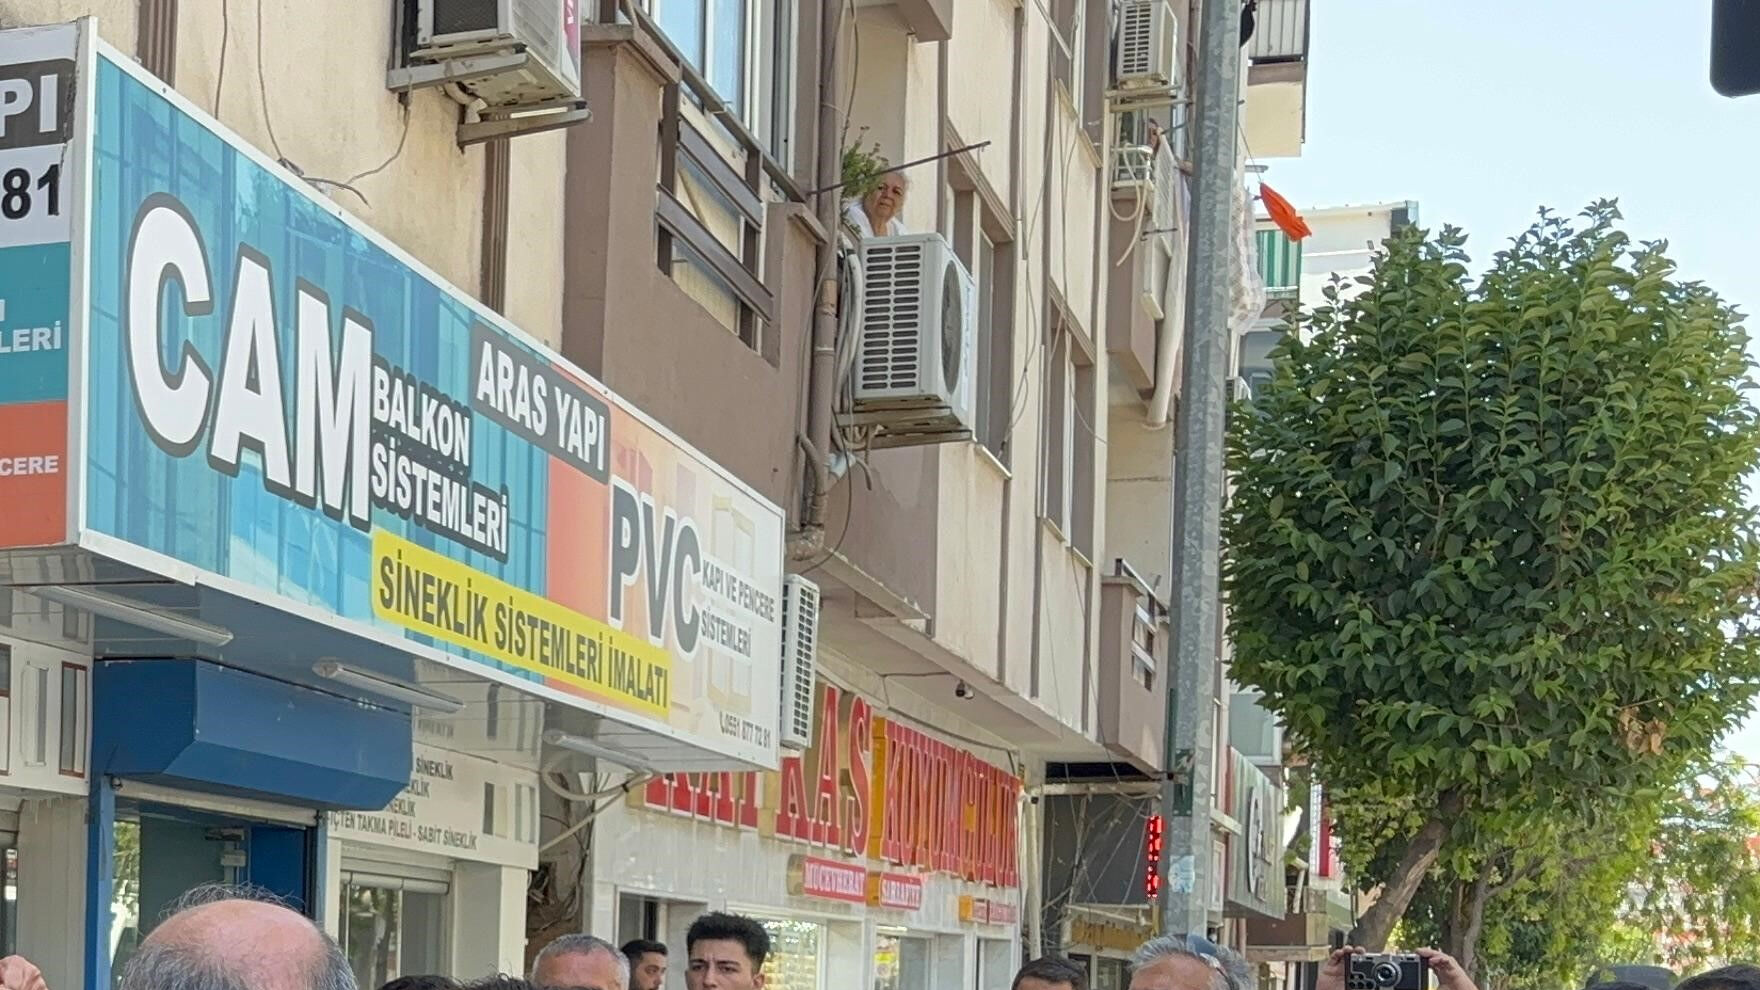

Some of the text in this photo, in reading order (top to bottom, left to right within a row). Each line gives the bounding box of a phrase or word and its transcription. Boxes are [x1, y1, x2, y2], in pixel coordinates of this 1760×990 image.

[0, 164, 62, 220] 81
[128, 206, 373, 523] CAM
[372, 365, 471, 467] BALKON
[476, 341, 605, 471] ARAS YAPI
[371, 436, 508, 555] SİSTEMLERİ
[611, 484, 702, 654] PVC
[702, 559, 775, 624] KAPI VE PENCERE
[379, 549, 669, 709] SİNEKLİK SİSTEMLERİ İMALATI
[443, 827, 478, 851] SİNEKLİK
